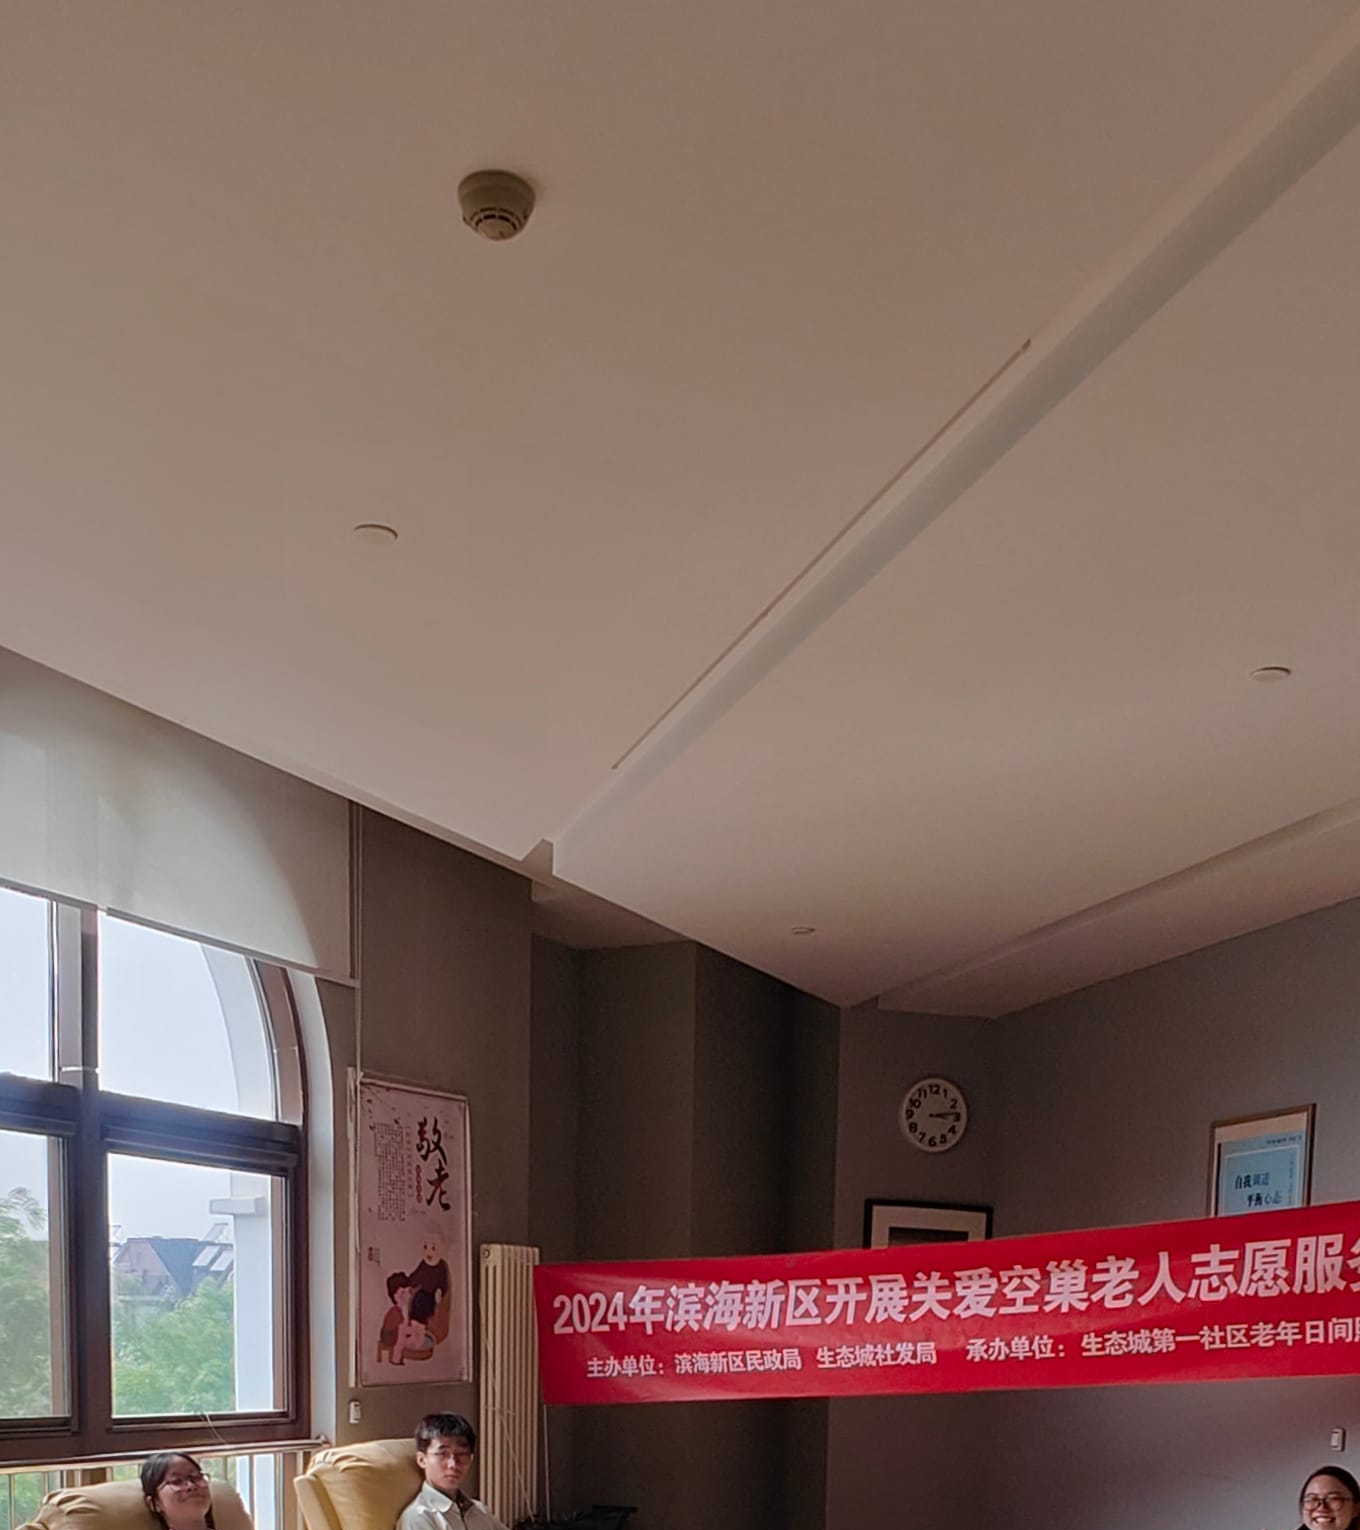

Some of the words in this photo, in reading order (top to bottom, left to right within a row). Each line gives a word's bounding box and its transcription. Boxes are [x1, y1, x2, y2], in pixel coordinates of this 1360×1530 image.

[928, 1084, 940, 1095] 12
[949, 1098, 958, 1109] 2
[928, 1136, 937, 1147] 6
[416, 1116, 452, 1212] 敬老
[816, 1341, 937, 1370] 生态城社发局
